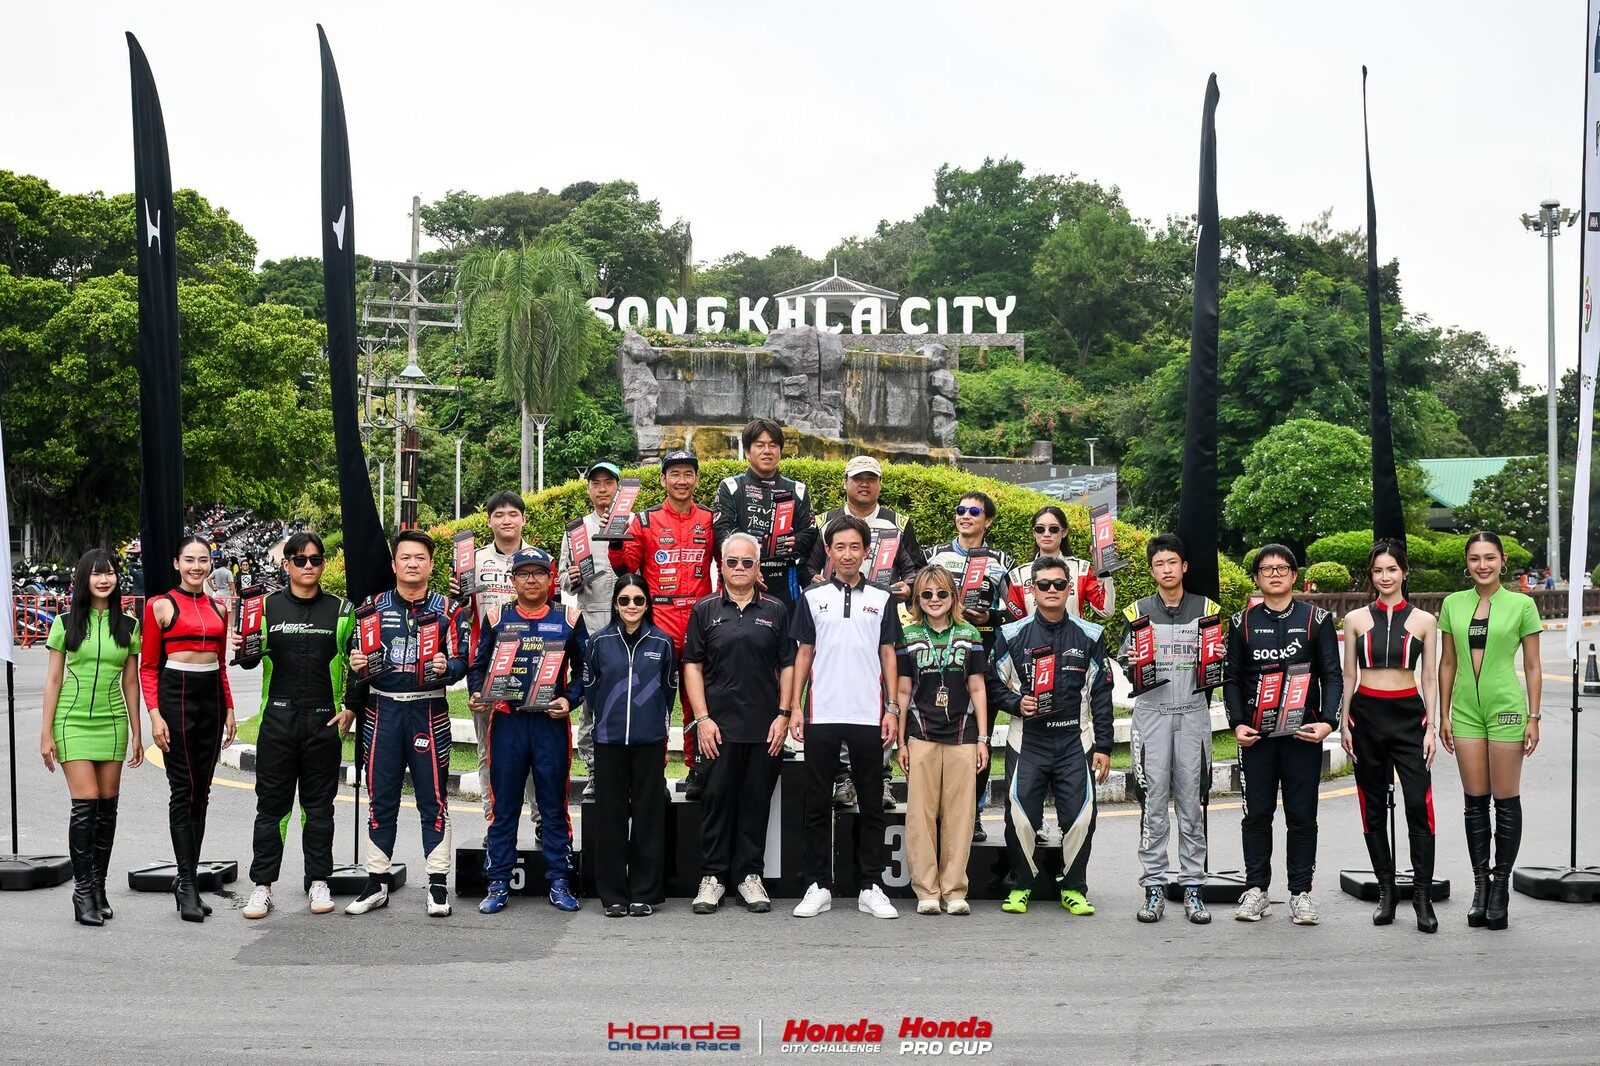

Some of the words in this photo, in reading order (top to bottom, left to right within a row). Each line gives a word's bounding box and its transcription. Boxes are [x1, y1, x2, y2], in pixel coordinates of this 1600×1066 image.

[900, 295, 1017, 335] CITY
[779, 514, 787, 530] 1
[460, 551, 471, 568] 2
[881, 551, 890, 564] 1
[480, 572, 512, 583] CIT
[967, 568, 981, 584] 3
[247, 612, 257, 629] 1
[365, 630, 374, 647] 1
[422, 639, 434, 656] 2
[1139, 643, 1149, 660] 2
[1206, 641, 1216, 658] 1
[1253, 637, 1303, 661] SOCKSY
[495, 655, 510, 671] 2
[541, 665, 555, 680] 3
[1037, 671, 1050, 685] 4
[1262, 688, 1276, 704] 5
[1289, 688, 1303, 704] 3
[881, 824, 910, 887] 3
